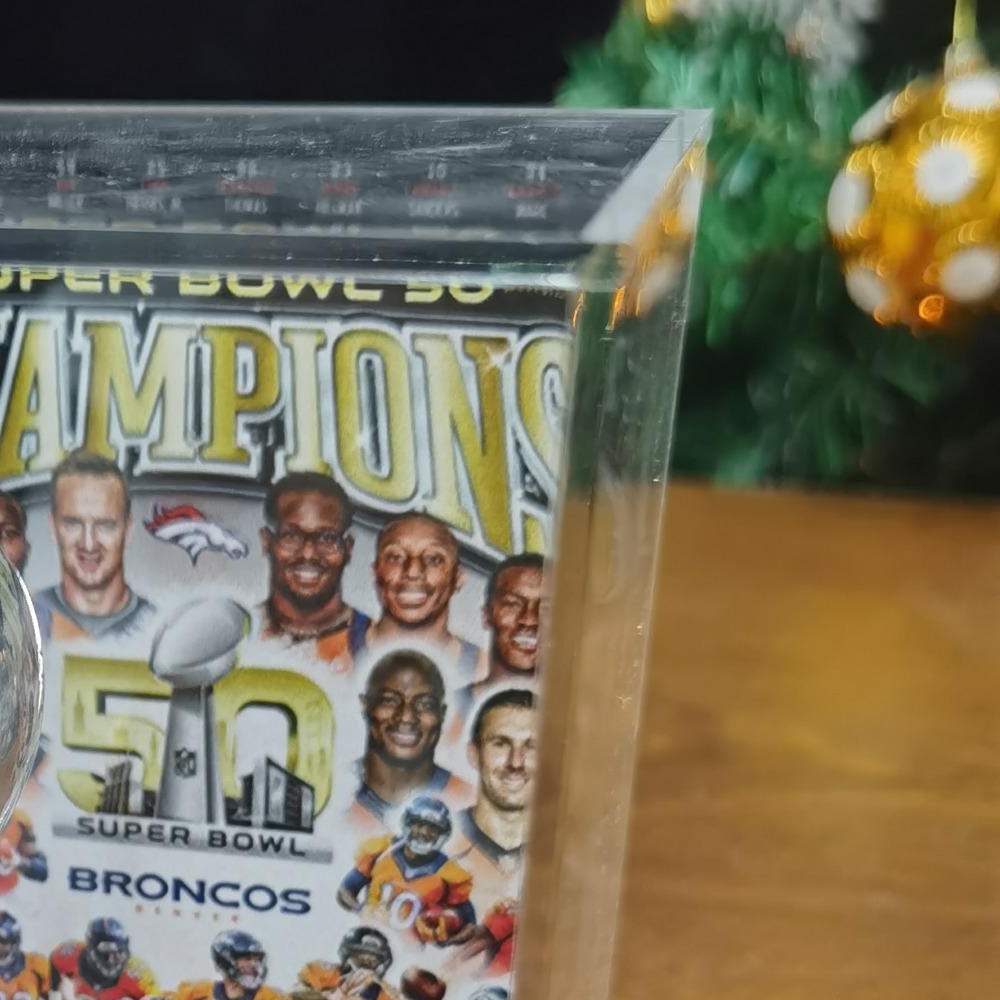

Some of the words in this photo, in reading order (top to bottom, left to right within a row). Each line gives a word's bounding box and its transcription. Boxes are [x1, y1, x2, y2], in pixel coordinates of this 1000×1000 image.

[76, 816, 191, 846] SUPER
[207, 829, 306, 857] BOWL
[68, 866, 312, 915] BRONCOS
